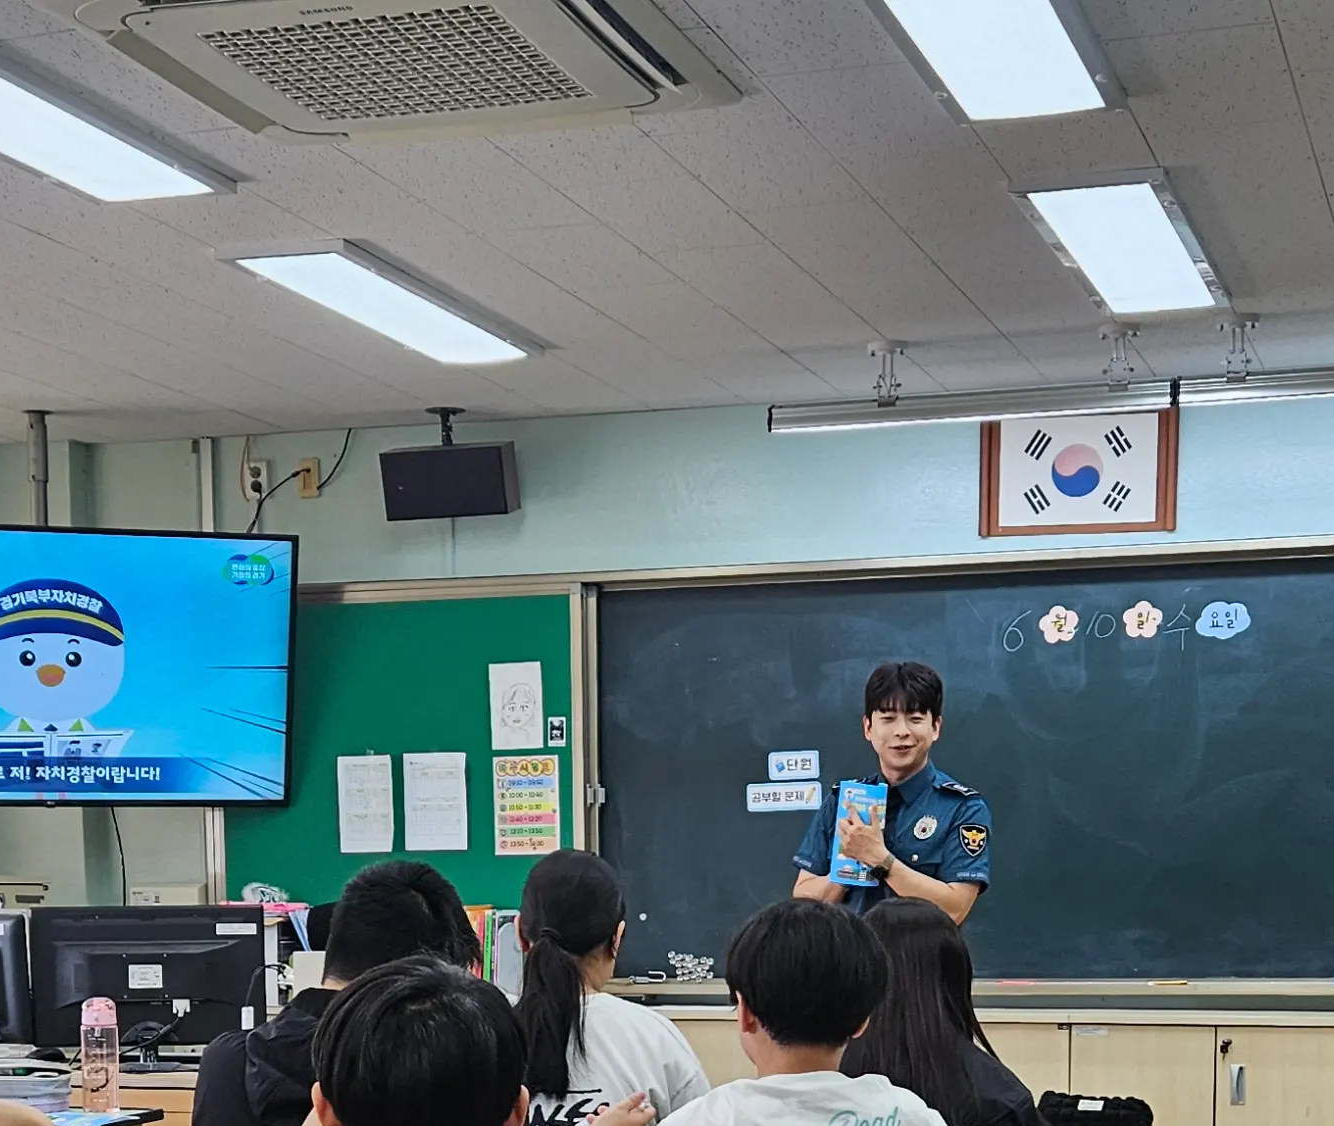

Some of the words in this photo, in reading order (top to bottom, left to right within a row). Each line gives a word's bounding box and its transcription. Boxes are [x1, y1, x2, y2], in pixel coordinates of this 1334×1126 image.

[298, 5, 354, 16] SAMSUNG
[786, 758, 812, 772] 단원
[10, 766, 31, 781] 저!
[36, 766, 161, 784] 자치경찰이랍니다!
[751, 791, 781, 804] 공부할
[784, 790, 805, 802] 문제
